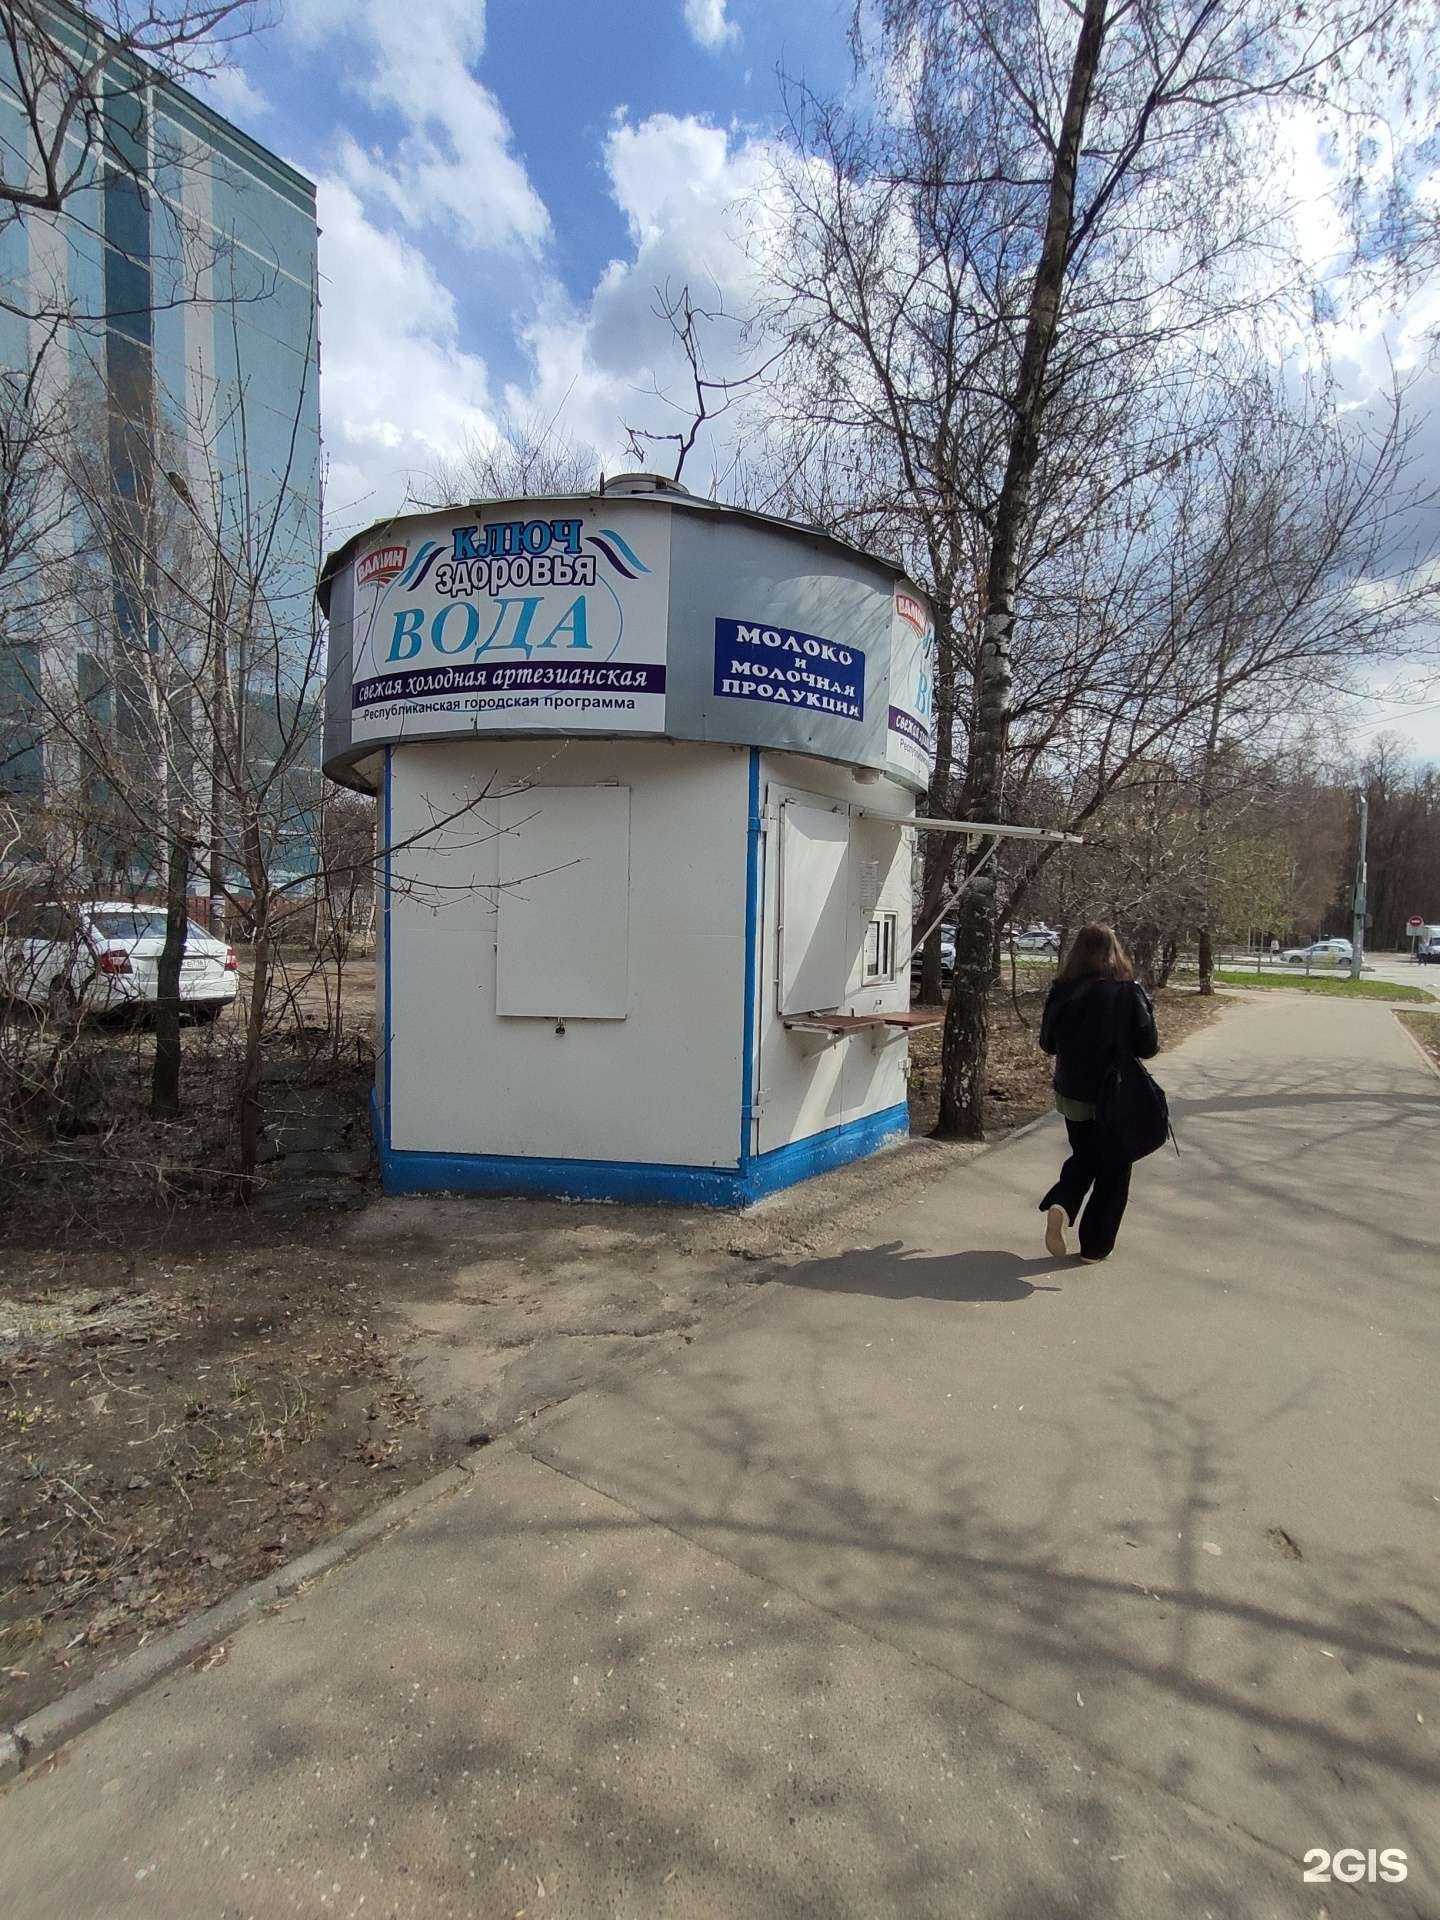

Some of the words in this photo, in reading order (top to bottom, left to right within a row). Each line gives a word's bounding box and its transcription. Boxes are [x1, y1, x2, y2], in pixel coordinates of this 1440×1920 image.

[452, 519, 584, 562] КЛЮЧ
[357, 549, 405, 578] ВАМИН
[385, 595, 593, 664] ВОДА
[736, 625, 853, 665] МОЛОКО
[359, 679, 403, 702] свежая
[405, 668, 487, 695] холодная
[492, 667, 648, 690] артезианская
[721, 679, 860, 717] ПРОДУКЦИЯ
[730, 660, 856, 698] МОЛОЧНАЯ
[364, 700, 460, 720] Республиканская
[464, 697, 539, 712] городская
[544, 697, 635, 711] программа
